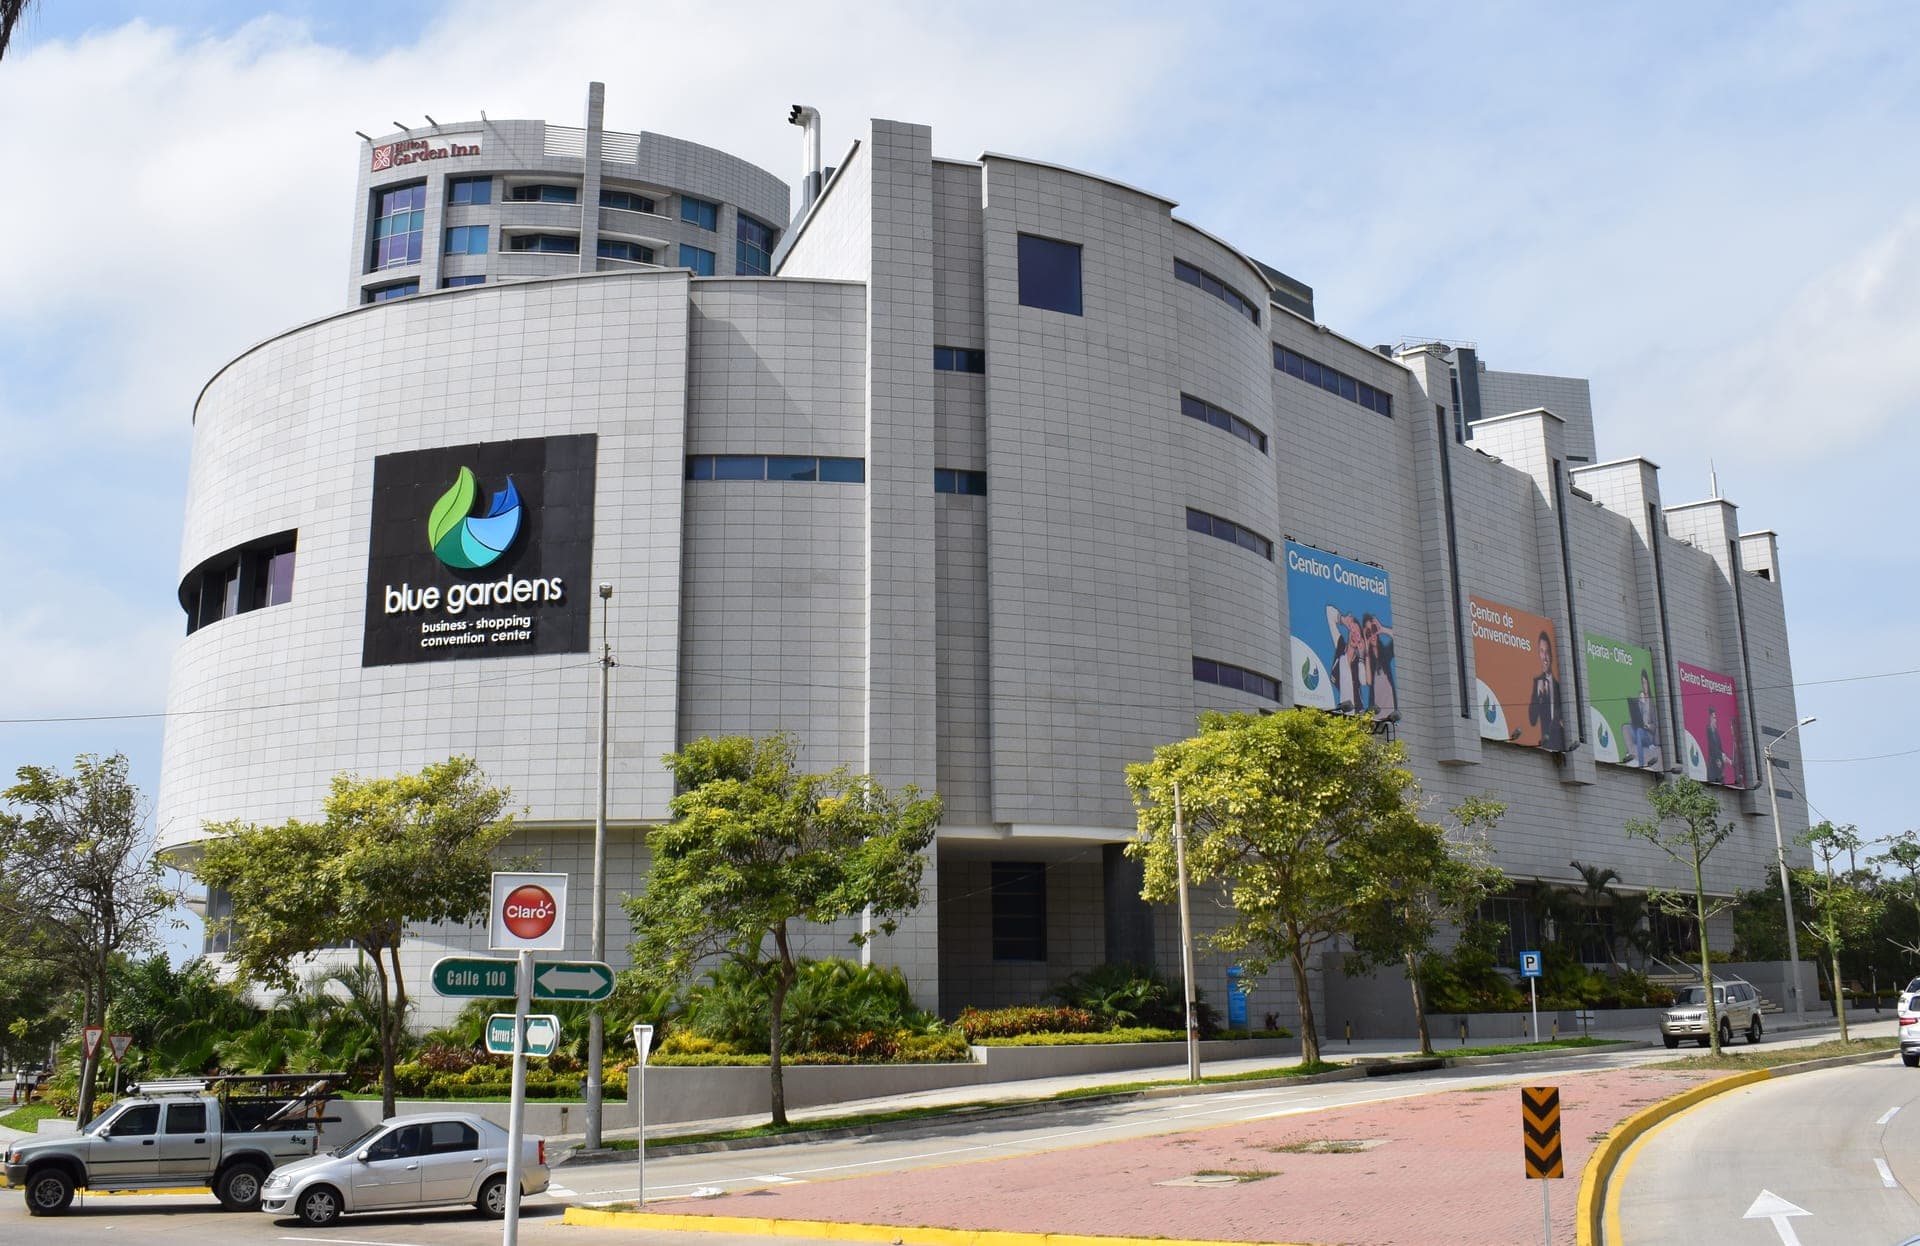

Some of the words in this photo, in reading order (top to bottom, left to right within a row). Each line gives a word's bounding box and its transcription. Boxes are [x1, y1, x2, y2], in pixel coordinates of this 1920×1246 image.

[394, 146, 448, 166] Garden
[451, 144, 480, 157] Inn
[1288, 550, 1330, 579] Centro
[1333, 563, 1387, 596] Comercial
[385, 583, 440, 614] blue
[447, 574, 562, 614] gardens
[422, 620, 467, 633] business
[476, 615, 531, 631] shopping
[1469, 602, 1500, 625] Centro
[1503, 612, 1514, 628] de
[421, 632, 485, 647] convention
[491, 629, 531, 642] center
[1471, 620, 1532, 652] Convenciones
[1680, 668, 1700, 685] Centro
[506, 904, 547, 919] Claro
[1526, 956, 1535, 969] P
[447, 970, 479, 986] Calle
[486, 970, 507, 986] 100
